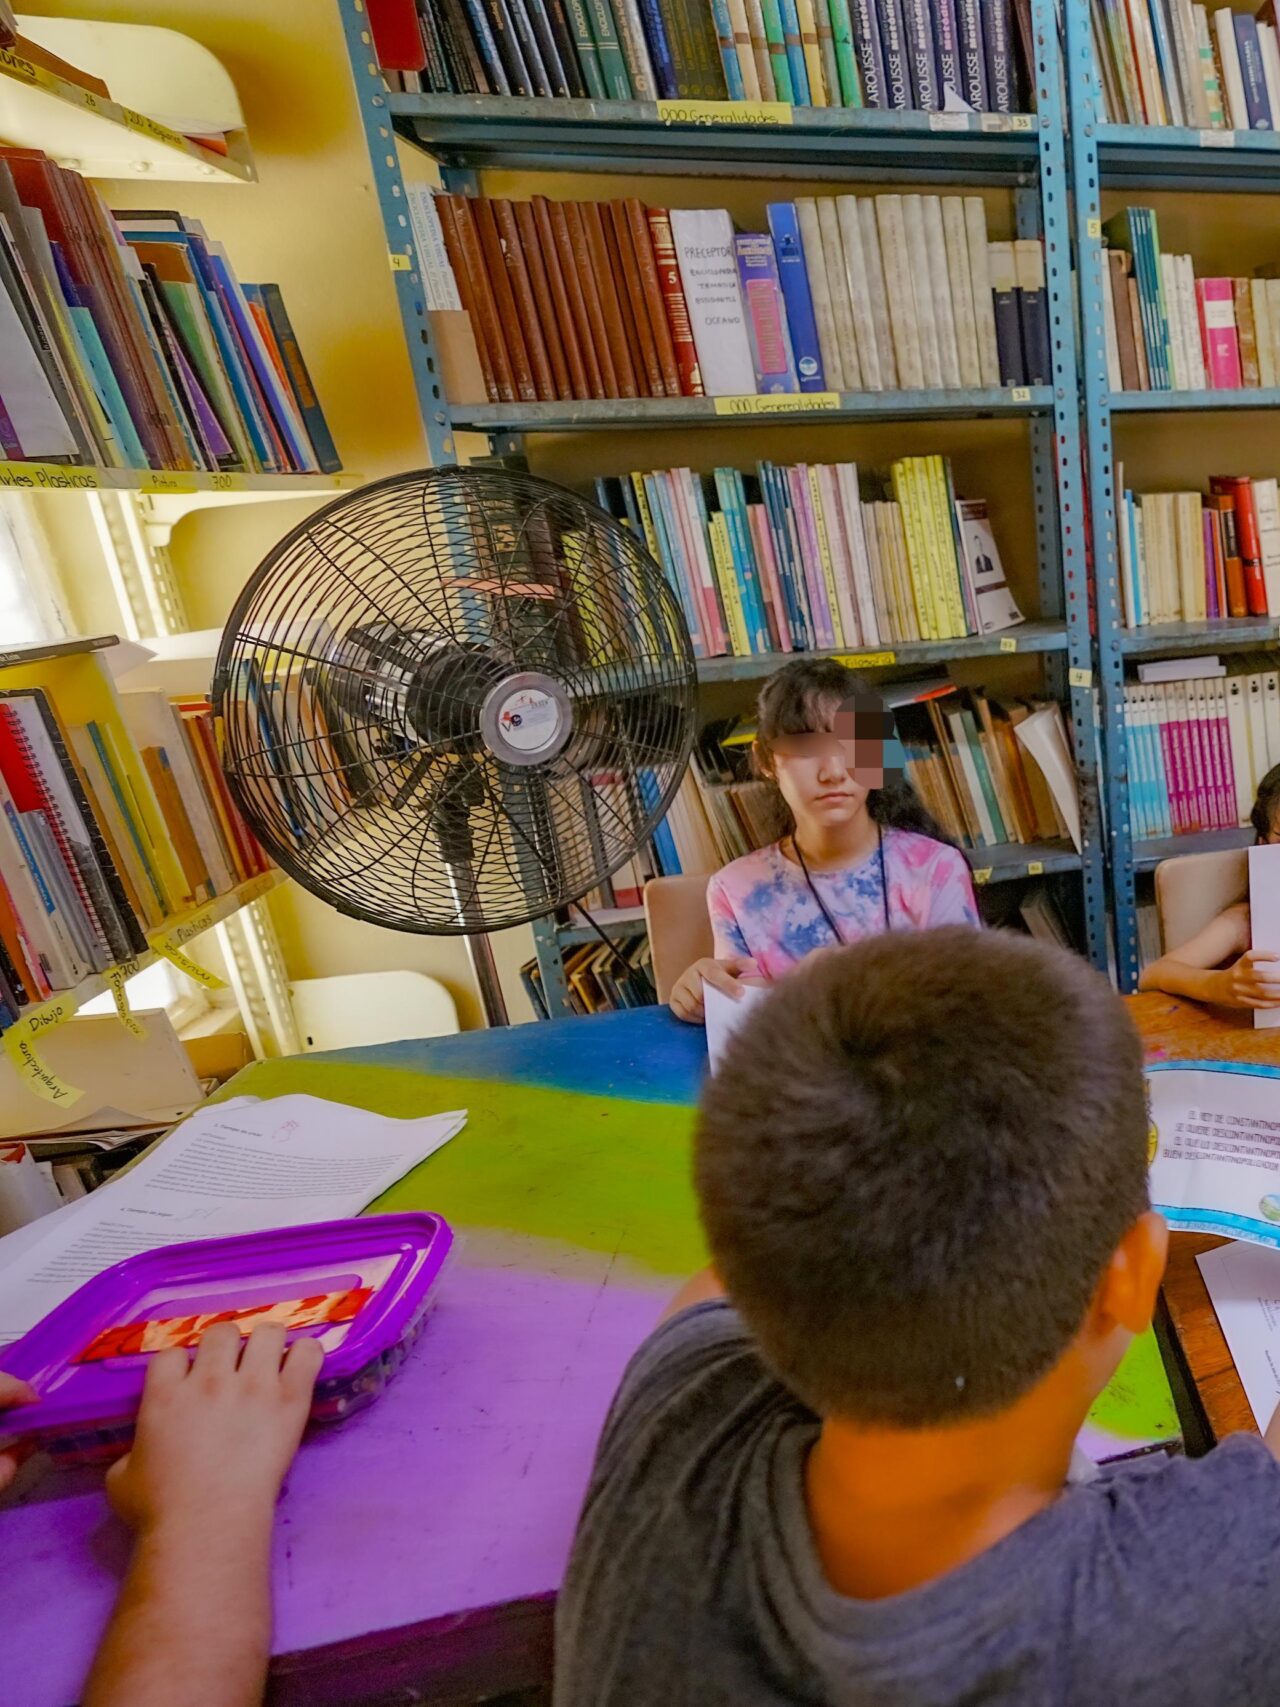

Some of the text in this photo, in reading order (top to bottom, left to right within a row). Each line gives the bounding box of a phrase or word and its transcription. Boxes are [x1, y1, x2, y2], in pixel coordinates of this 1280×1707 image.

[861, 42, 881, 108] AROUSSE
[889, 54, 906, 110] AROUSSE
[916, 52, 932, 110] AROUSSE
[941, 54, 956, 92] OUSSE
[966, 52, 983, 110] AROUSSE
[993, 55, 1008, 112] AROUSSE
[668, 271, 677, 284] 5
[28, 1005, 64, 1032] Dibujo
[18, 1039, 68, 1100] Arquitectura
